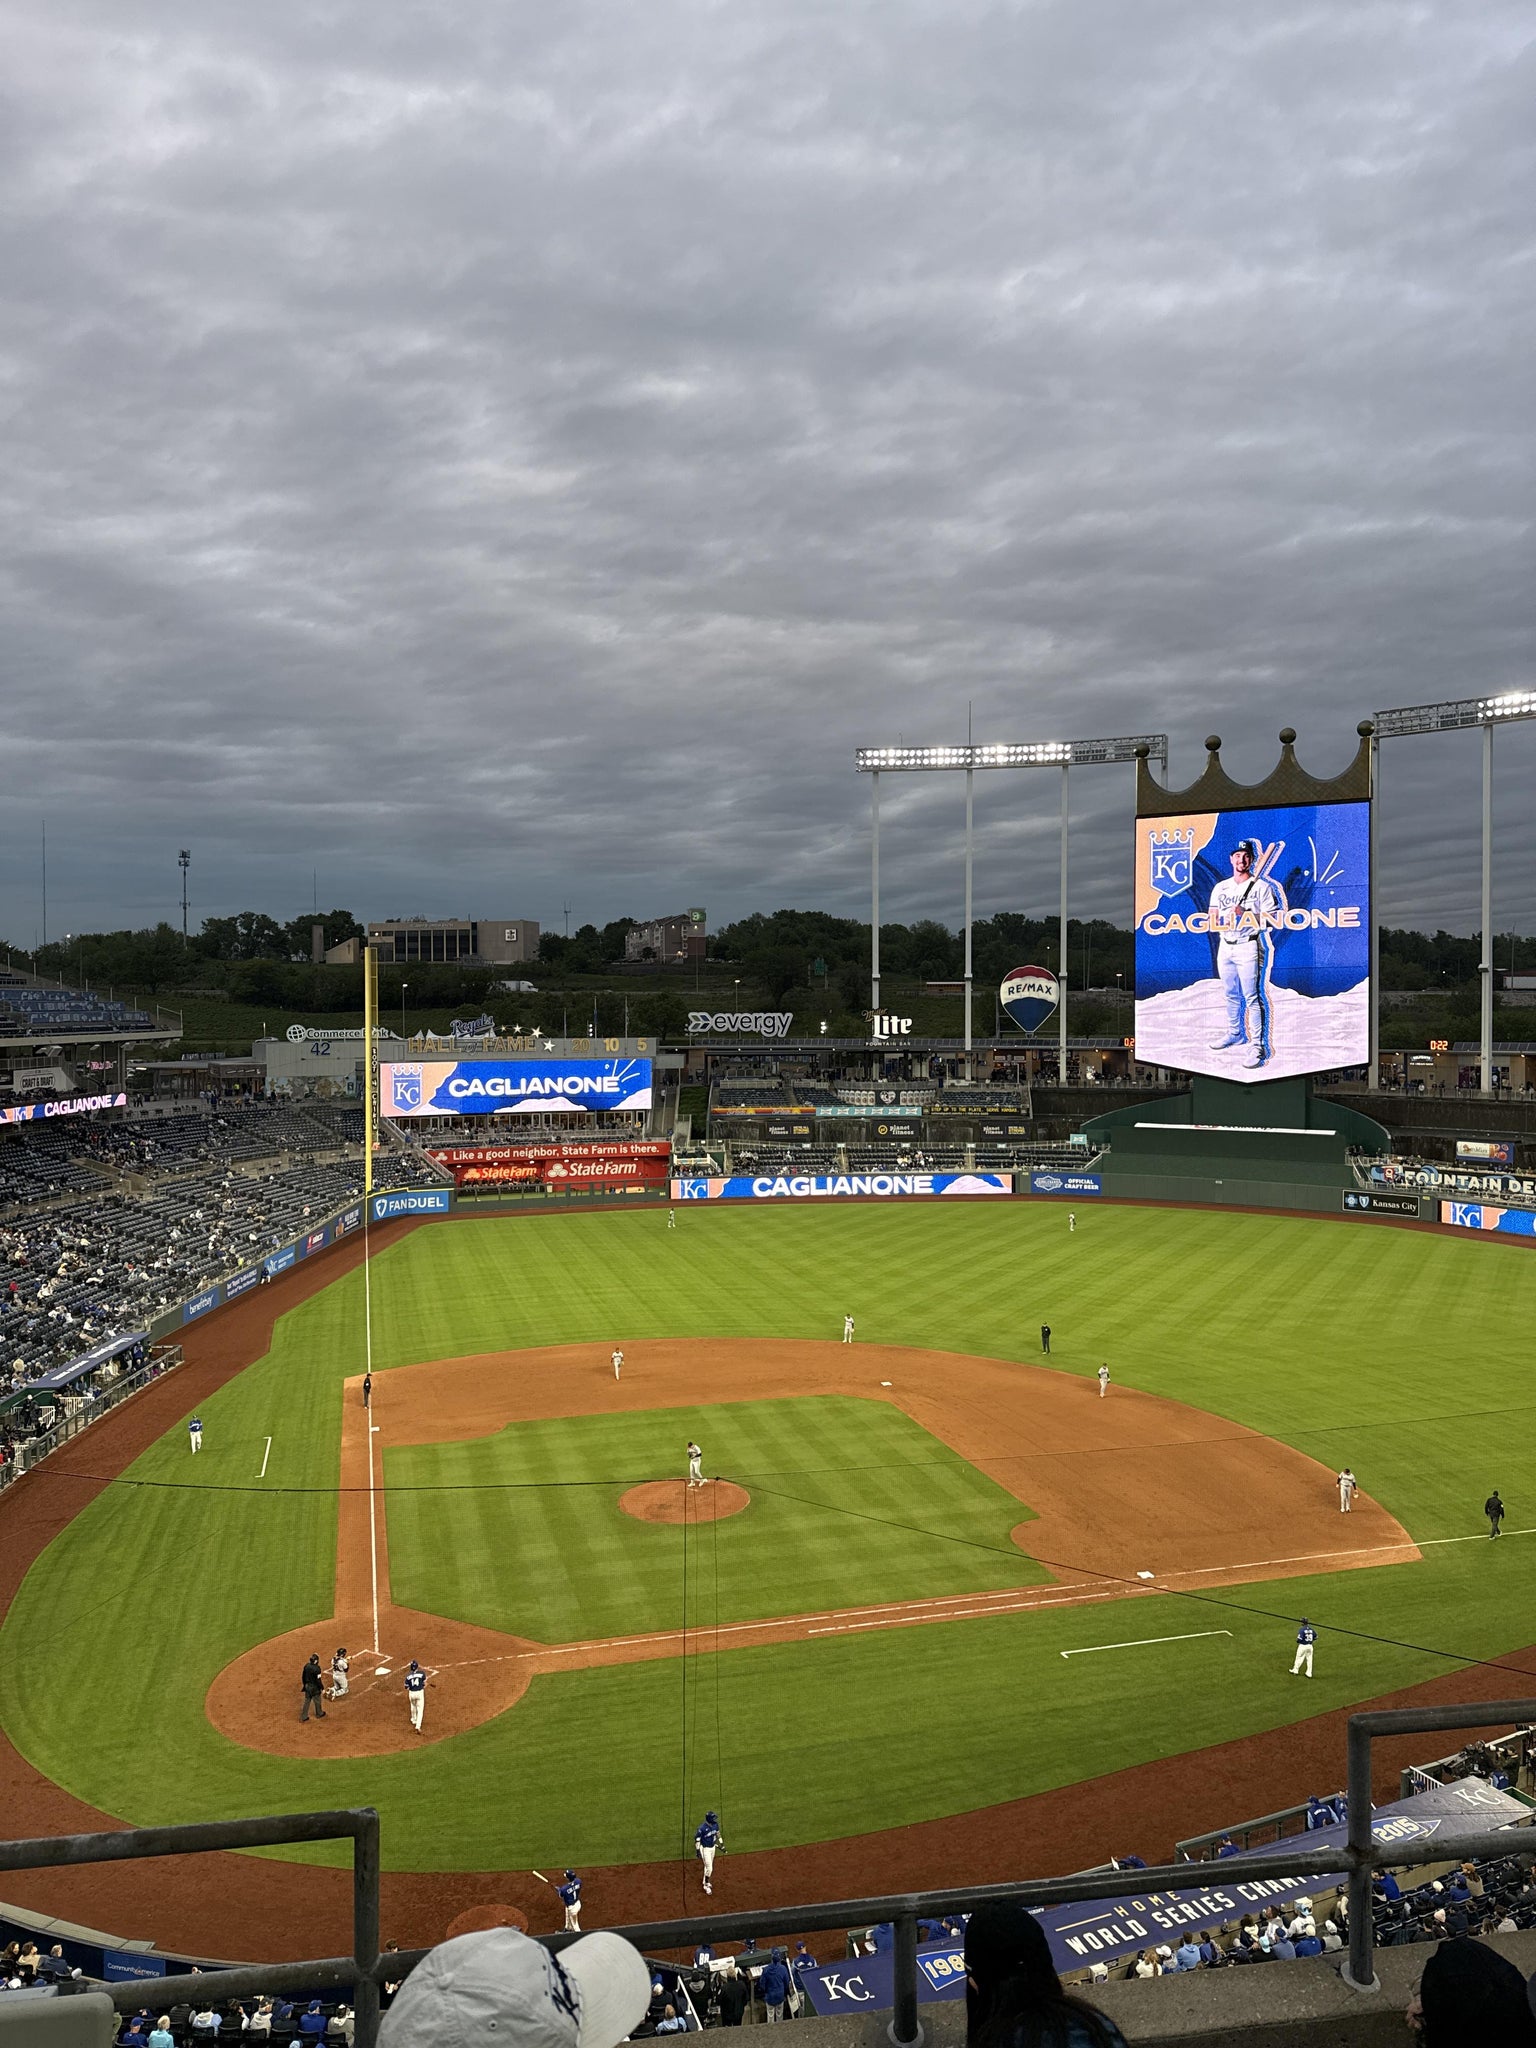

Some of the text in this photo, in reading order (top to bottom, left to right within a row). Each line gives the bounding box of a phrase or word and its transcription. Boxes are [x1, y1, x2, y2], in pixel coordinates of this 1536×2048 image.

[1154, 854, 1188, 886] KC
[1143, 906, 1361, 936] CAGLIANONE
[1007, 982, 1053, 996] RE/MAX
[306, 1028, 360, 1038] Commerce
[450, 1013, 495, 1037] Royals
[714, 1014, 790, 1037] evergy
[872, 1015, 913, 1040] Lite
[310, 1042, 331, 1056] 42
[408, 1037, 462, 1054] HALL
[482, 1036, 536, 1052] FAME
[603, 1038, 620, 1052] 10
[637, 1038, 647, 1052] 5
[1430, 1040, 1448, 1050] 0:22
[22, 1077, 36, 1088] CRAFT
[449, 1076, 620, 1097] CAGLIANONE
[395, 1082, 419, 1105] KC
[44, 1094, 112, 1117] CAGLIANONE
[453, 1150, 475, 1161] Like
[486, 1151, 509, 1162] good
[512, 1148, 560, 1161] neighbor,
[562, 1146, 588, 1156] State
[592, 1145, 617, 1155] Farm
[619, 1144, 628, 1154] is
[631, 1143, 660, 1154] there.
[682, 1180, 707, 1199] KC
[752, 1175, 934, 1197] CAGLIANONE
[1404, 1170, 1536, 1196] FOUNTAIN DE
[389, 1196, 444, 1211] FANDUEL
[1372, 1199, 1417, 1212] Kansas City
[1453, 1203, 1480, 1228] KC
[411, 1678, 419, 1686] 14
[1453, 1788, 1501, 1807] KC
[1372, 1817, 1420, 1842] 2015
[1113, 1890, 1182, 1918] HOME
[1065, 1919, 1148, 1956] WORLD
[1151, 1892, 1236, 1929] SERIES
[924, 1952, 966, 1979] 198
[819, 1974, 871, 2001] KC
